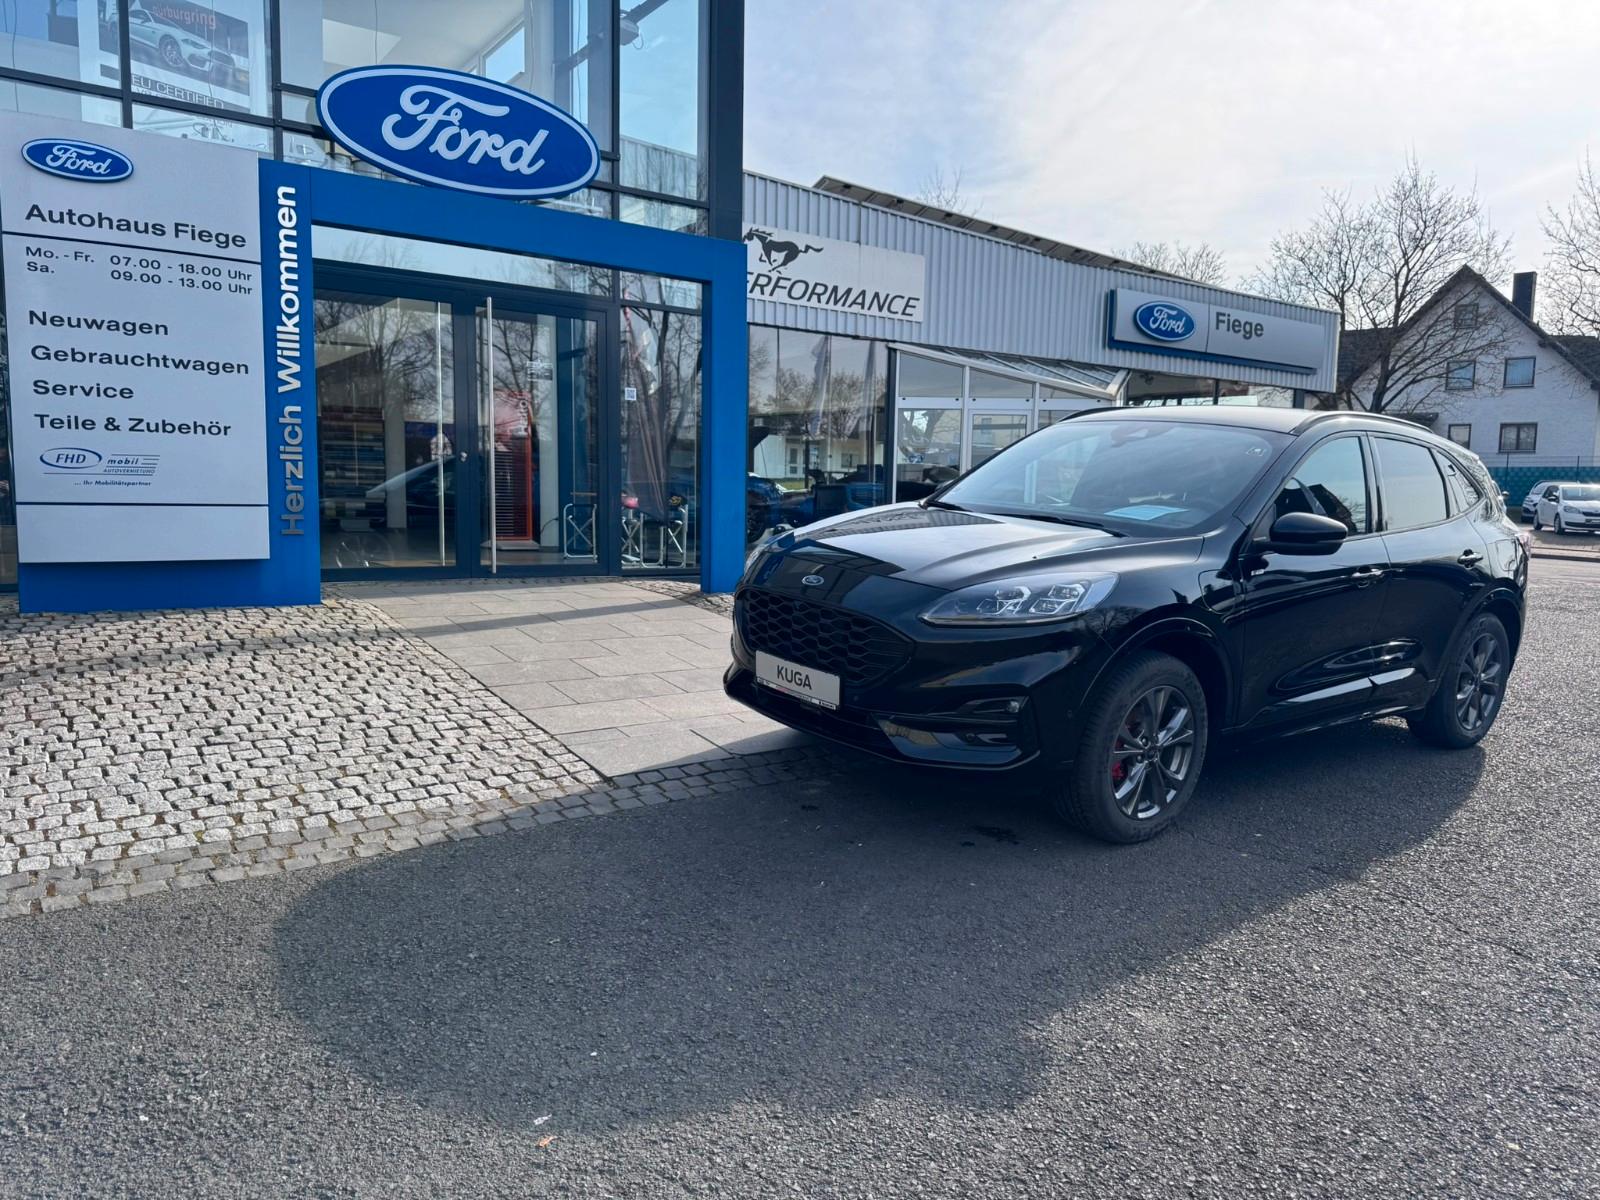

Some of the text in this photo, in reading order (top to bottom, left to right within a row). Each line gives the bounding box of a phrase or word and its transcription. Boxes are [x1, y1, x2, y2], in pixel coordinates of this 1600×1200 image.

[381, 84, 550, 176] Ford
[46, 144, 111, 175] Ford
[24, 204, 247, 249] Autohaus Fiege
[26, 261, 55, 274] Sa.
[110, 269, 162, 285] 09.00
[178, 277, 222, 292] 13.00
[228, 283, 253, 295] Uhr
[74, 251, 95, 263] Fr.
[109, 255, 161, 271] 07.00
[178, 263, 222, 278] 18.00
[227, 269, 252, 281] Uhr
[747, 271, 920, 317] RFORMANCE
[28, 310, 169, 337] Neuwagen
[1149, 306, 1186, 334] Ford
[1215, 311, 1264, 340] Fiege
[30, 344, 249, 375] Gebrauchtwagen
[276, 186, 305, 535] Herzlich Willkommen
[32, 379, 134, 399] Service
[34, 413, 232, 436] Teile & Zubehör
[56, 453, 87, 464] FHD
[107, 457, 139, 465] mobil
[776, 664, 812, 690] KUGA
